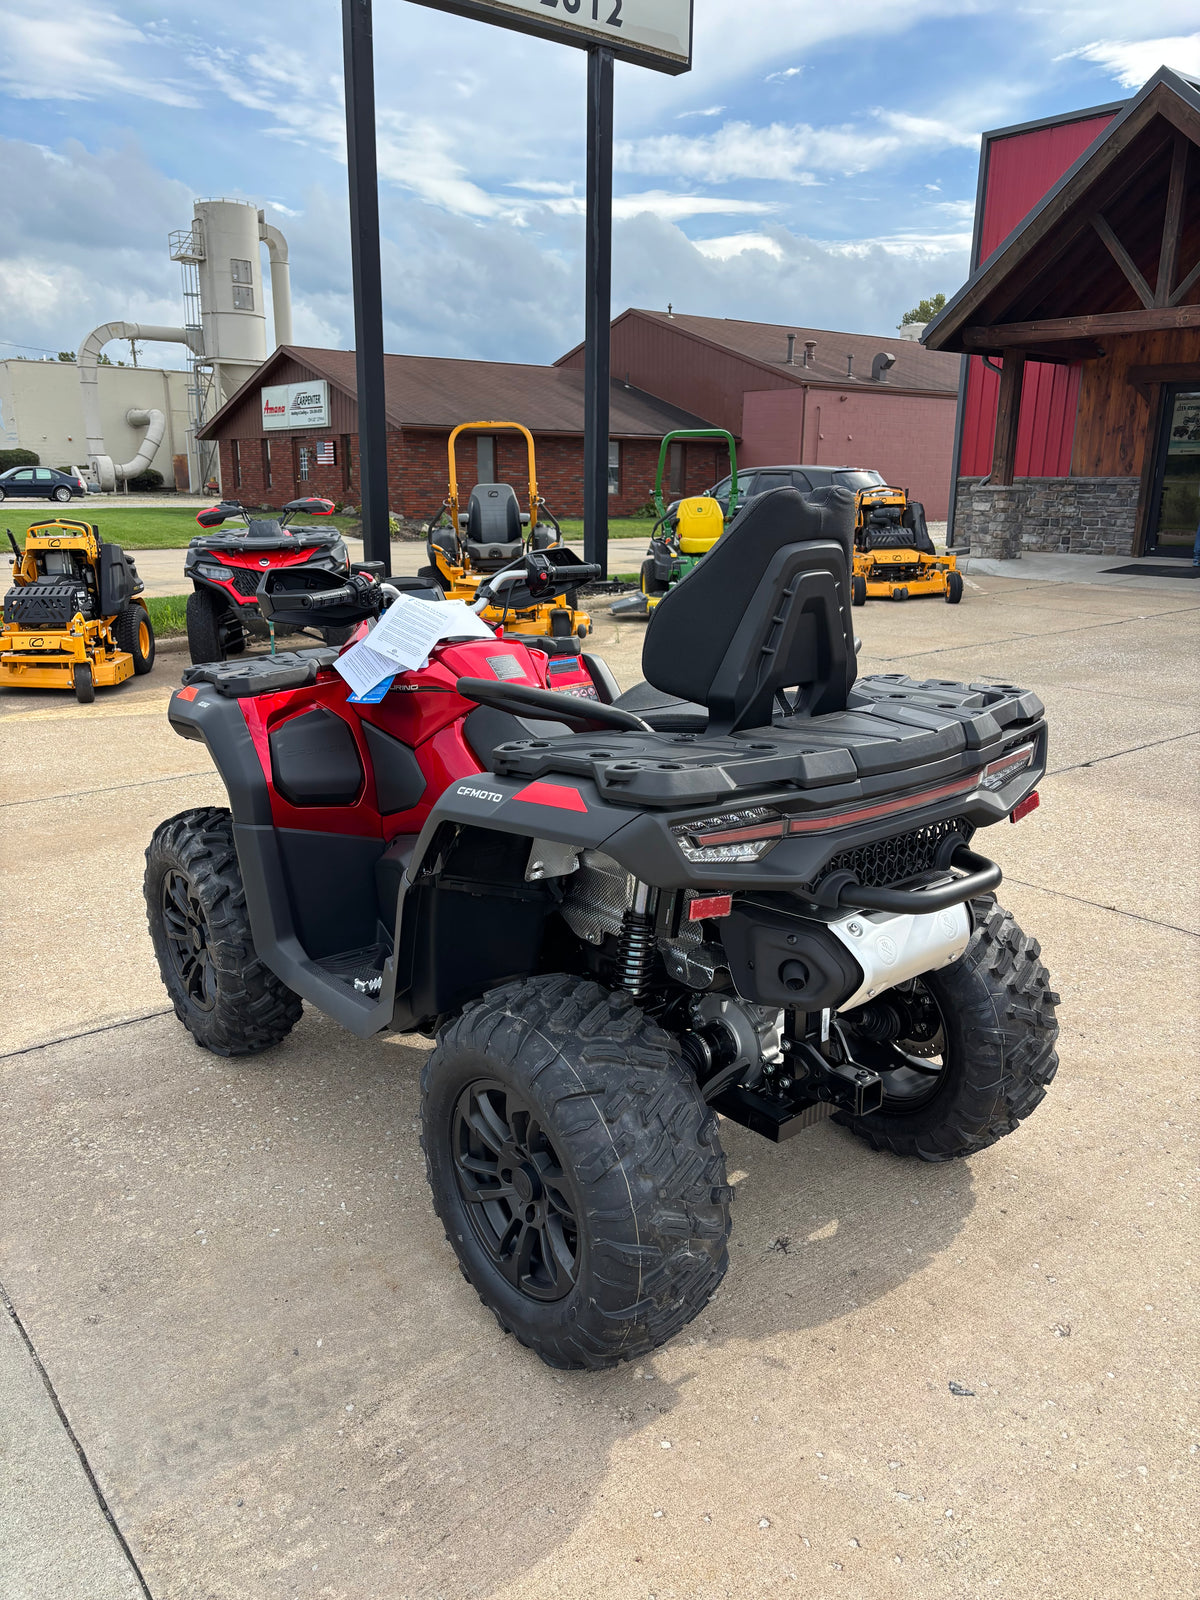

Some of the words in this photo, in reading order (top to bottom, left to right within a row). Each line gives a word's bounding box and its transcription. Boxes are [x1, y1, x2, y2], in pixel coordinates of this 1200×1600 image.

[264, 399, 285, 414] Amana
[297, 394, 321, 405] CARPENTER
[456, 786, 503, 803] CFMOTO
